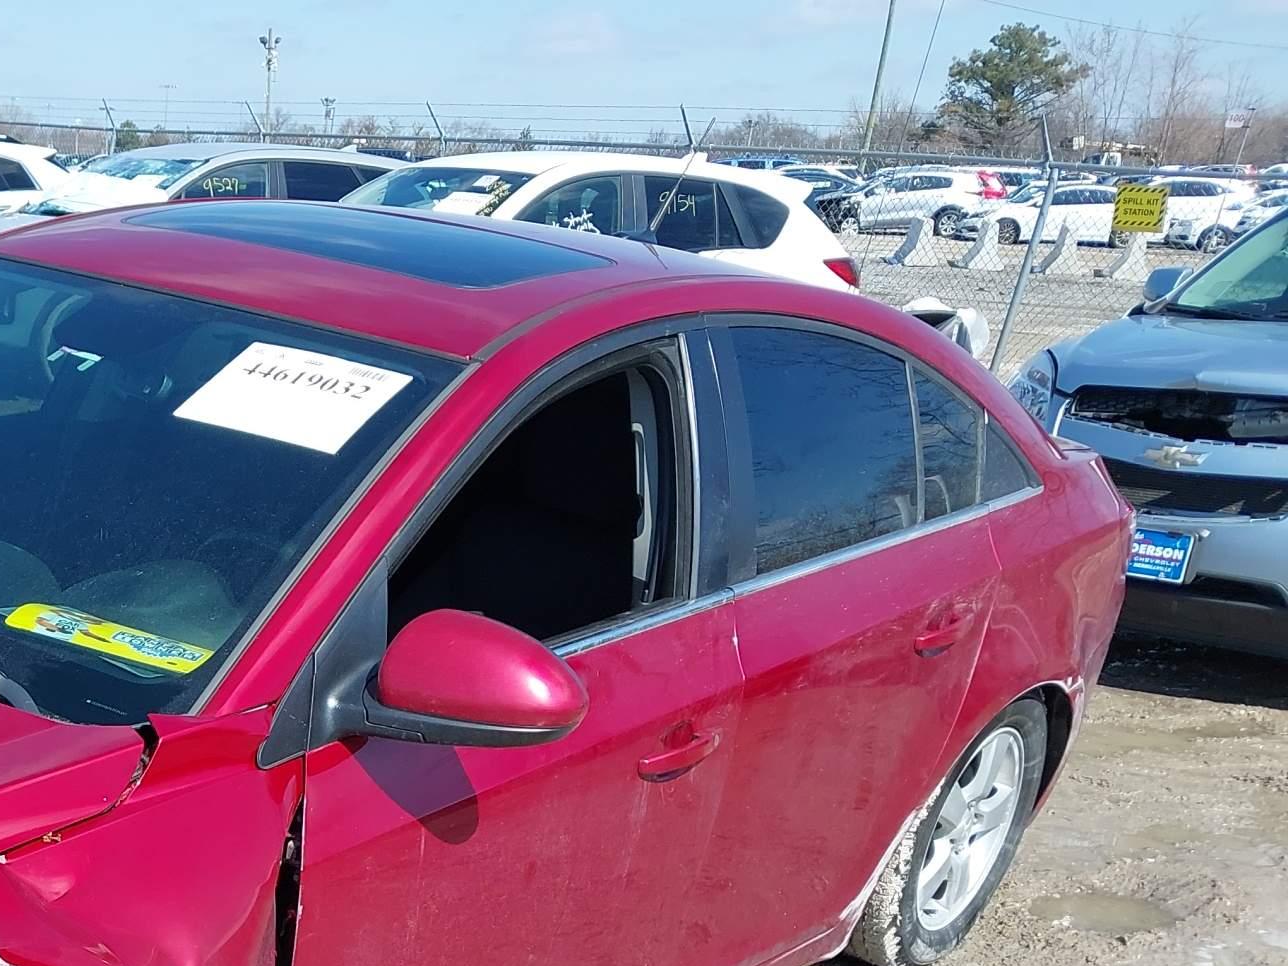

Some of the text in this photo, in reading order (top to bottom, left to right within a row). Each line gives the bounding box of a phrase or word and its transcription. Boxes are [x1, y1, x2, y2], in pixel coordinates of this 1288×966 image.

[203, 177, 239, 198] 9527
[659, 191, 696, 217] 9154
[1122, 197, 1160, 206] SPILL KIT
[1122, 207, 1155, 216] STATION
[242, 362, 372, 400] 44619032
